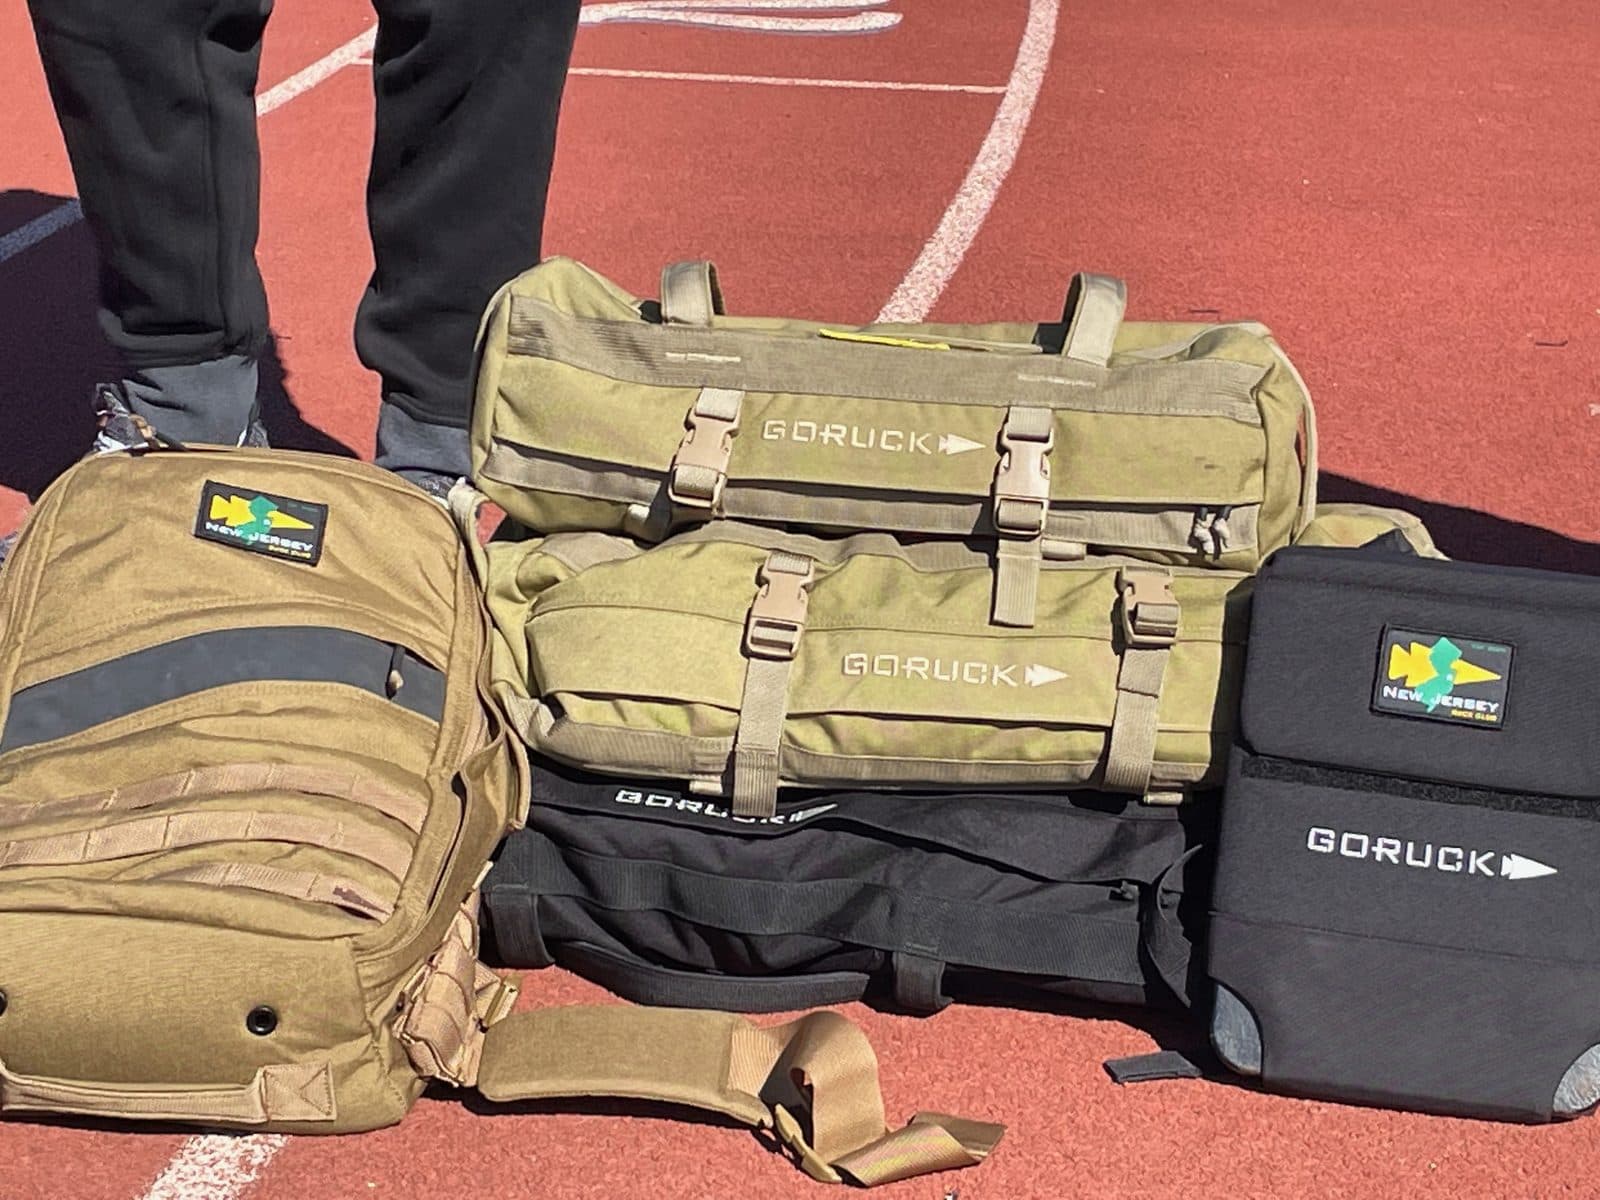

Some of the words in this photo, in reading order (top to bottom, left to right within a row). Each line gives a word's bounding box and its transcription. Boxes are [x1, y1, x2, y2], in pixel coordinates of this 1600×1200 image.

[763, 419, 932, 455] GORUCK
[205, 521, 243, 538] NEW
[248, 531, 314, 551] JERSEY
[843, 653, 1018, 687] GORUCK
[1382, 685, 1424, 703] NEW
[1430, 692, 1500, 713] JERSEY
[1307, 827, 1496, 877] GORUCK
